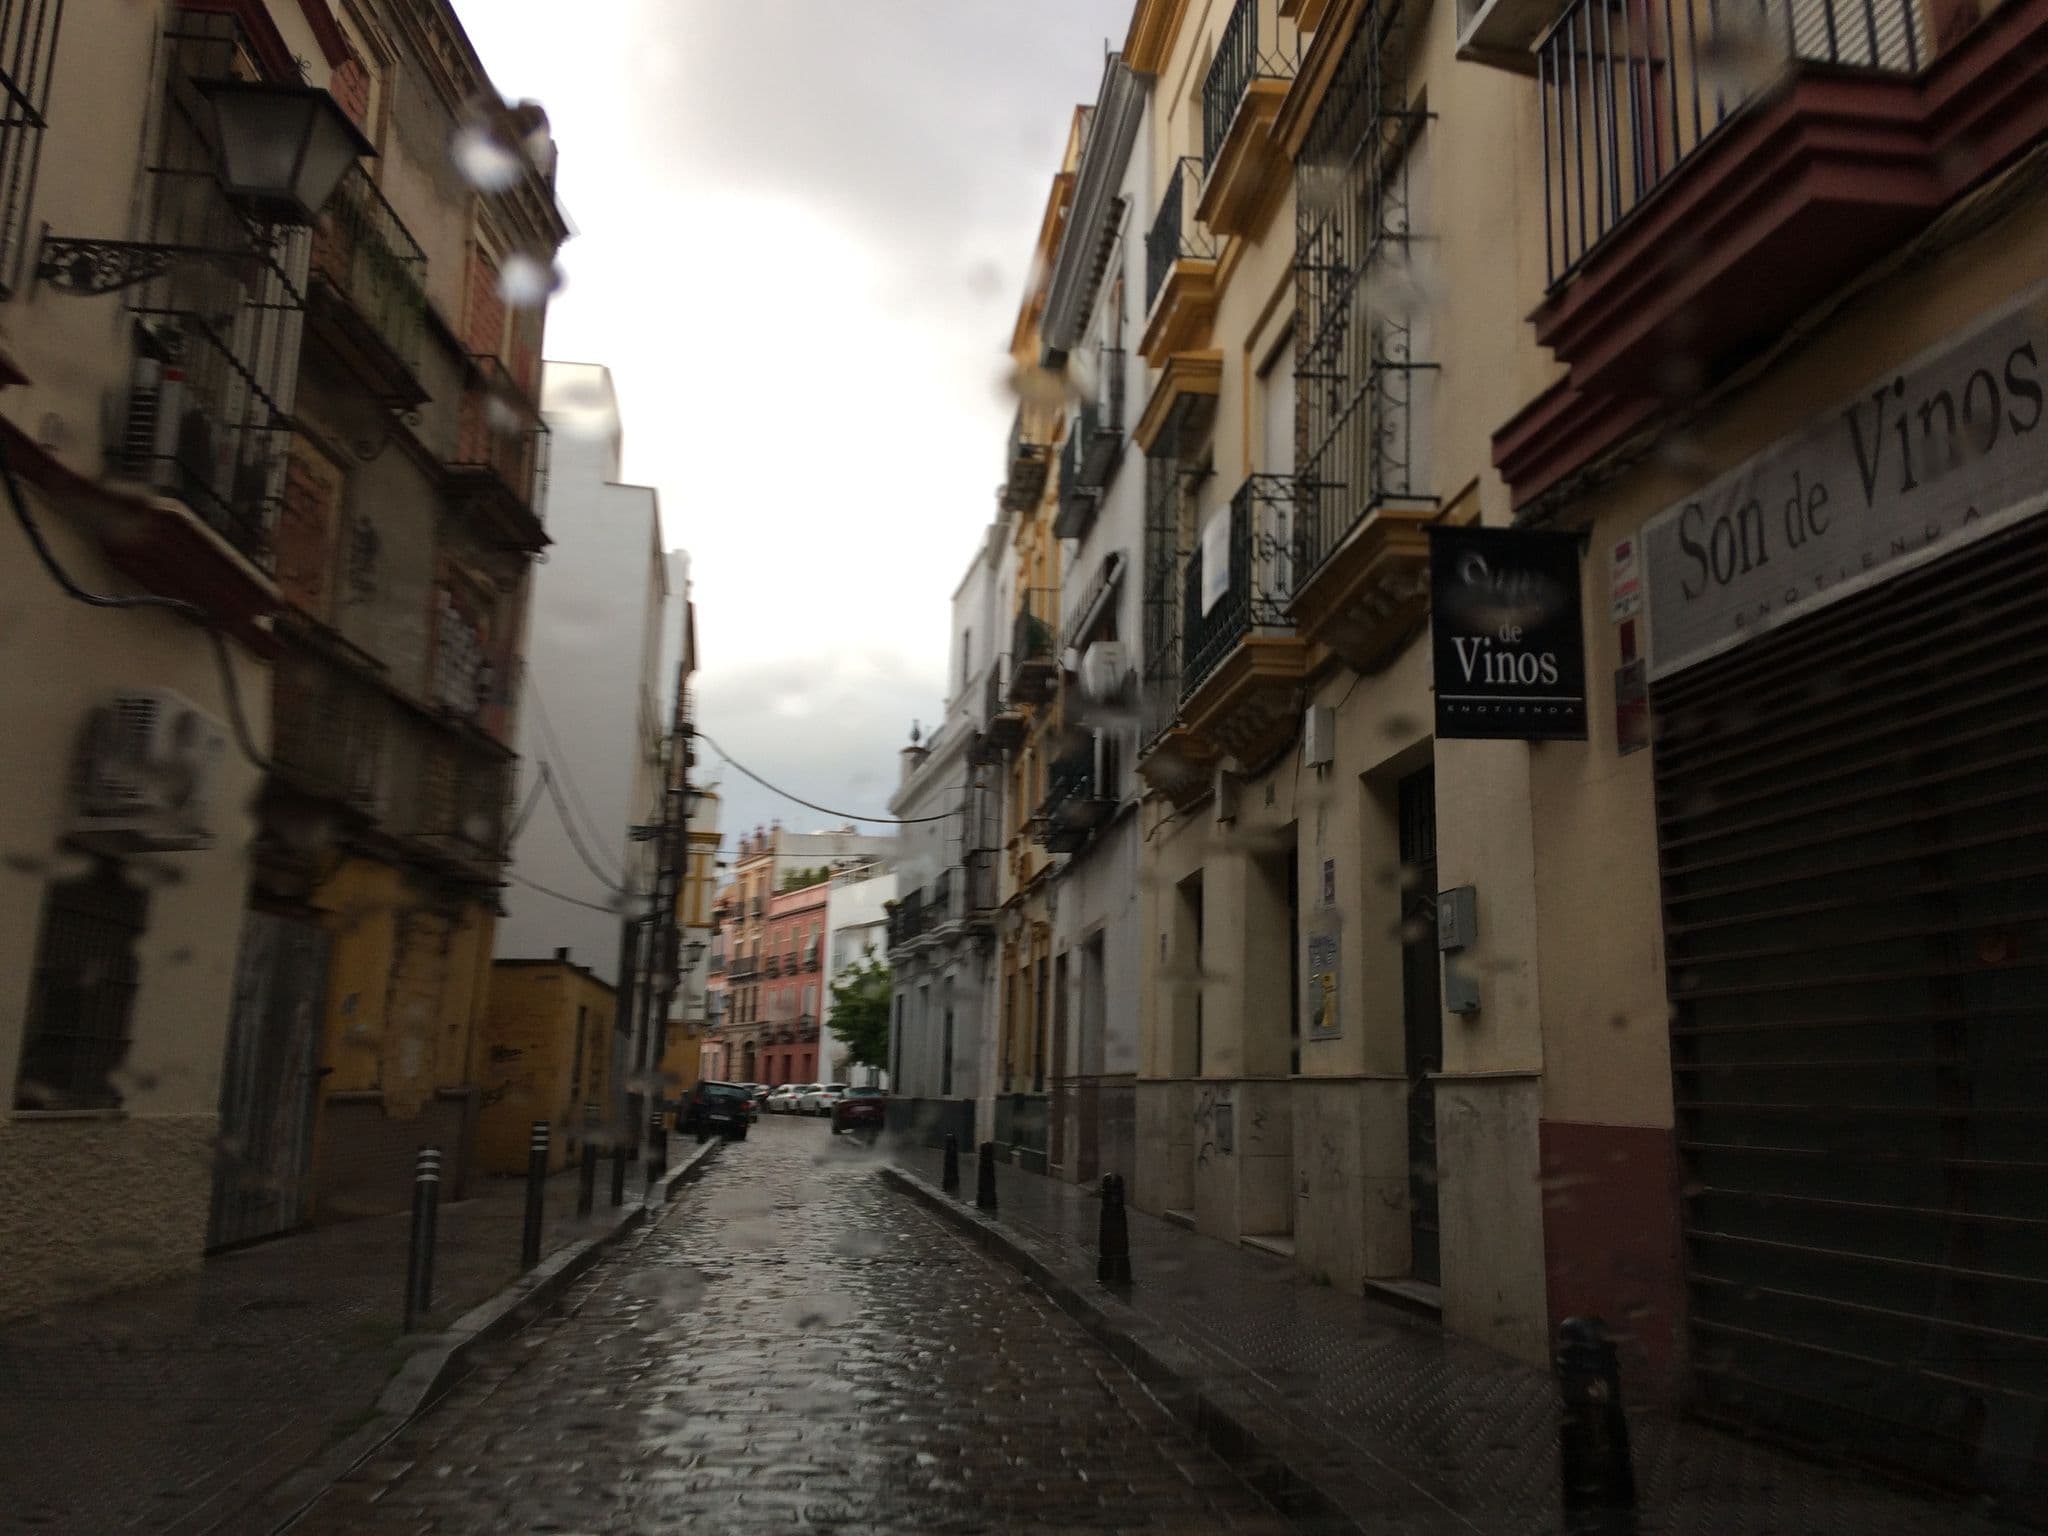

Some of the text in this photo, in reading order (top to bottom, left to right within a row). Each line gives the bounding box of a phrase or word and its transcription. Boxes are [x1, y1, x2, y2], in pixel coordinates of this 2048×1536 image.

[1679, 500, 1769, 601] Son
[1785, 471, 1829, 550] de
[1841, 341, 2044, 508] Vinos
[1498, 623, 1523, 643] de
[1450, 636, 1560, 686] Vinos
[1447, 704, 1575, 715] ENOTIENDA
